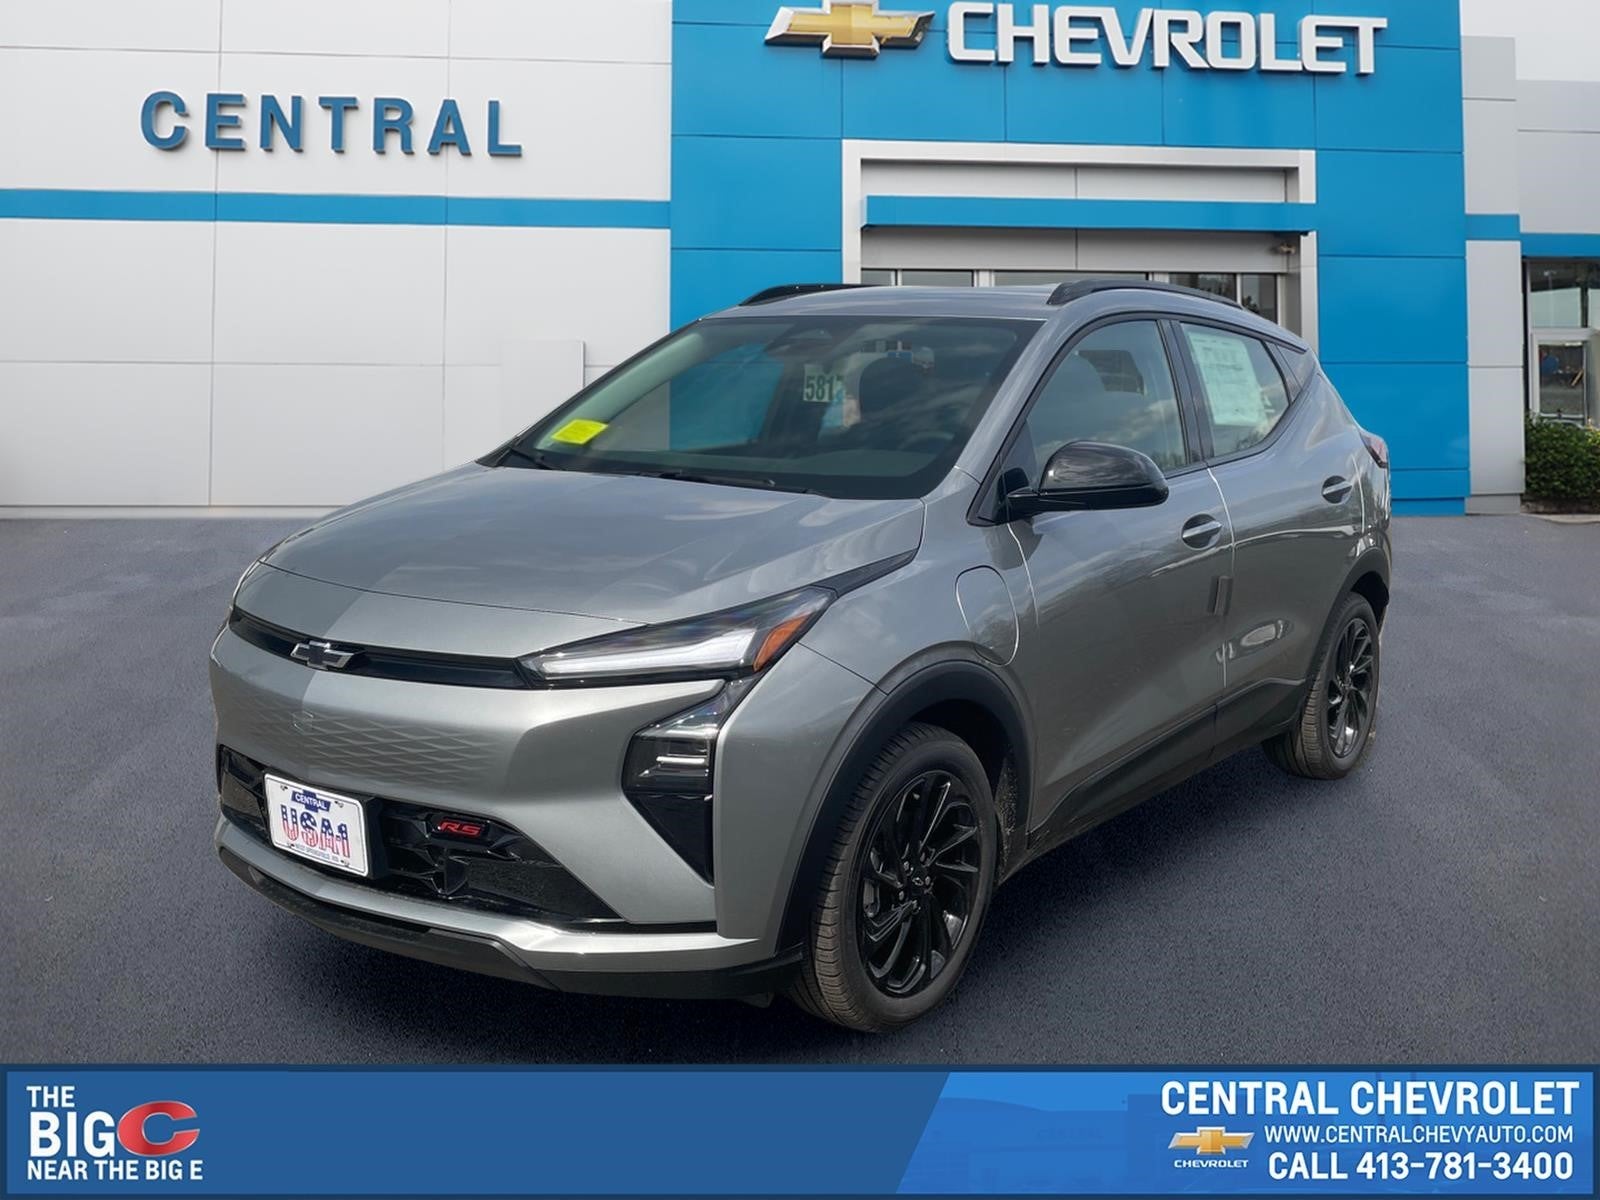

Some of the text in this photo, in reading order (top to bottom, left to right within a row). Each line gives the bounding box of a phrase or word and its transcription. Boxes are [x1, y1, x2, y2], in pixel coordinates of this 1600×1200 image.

[947, 1, 1388, 75] CHEVROLET
[140, 90, 523, 158] CENTRAL
[294, 792, 329, 811] CENTRAL
[440, 820, 481, 837] RS
